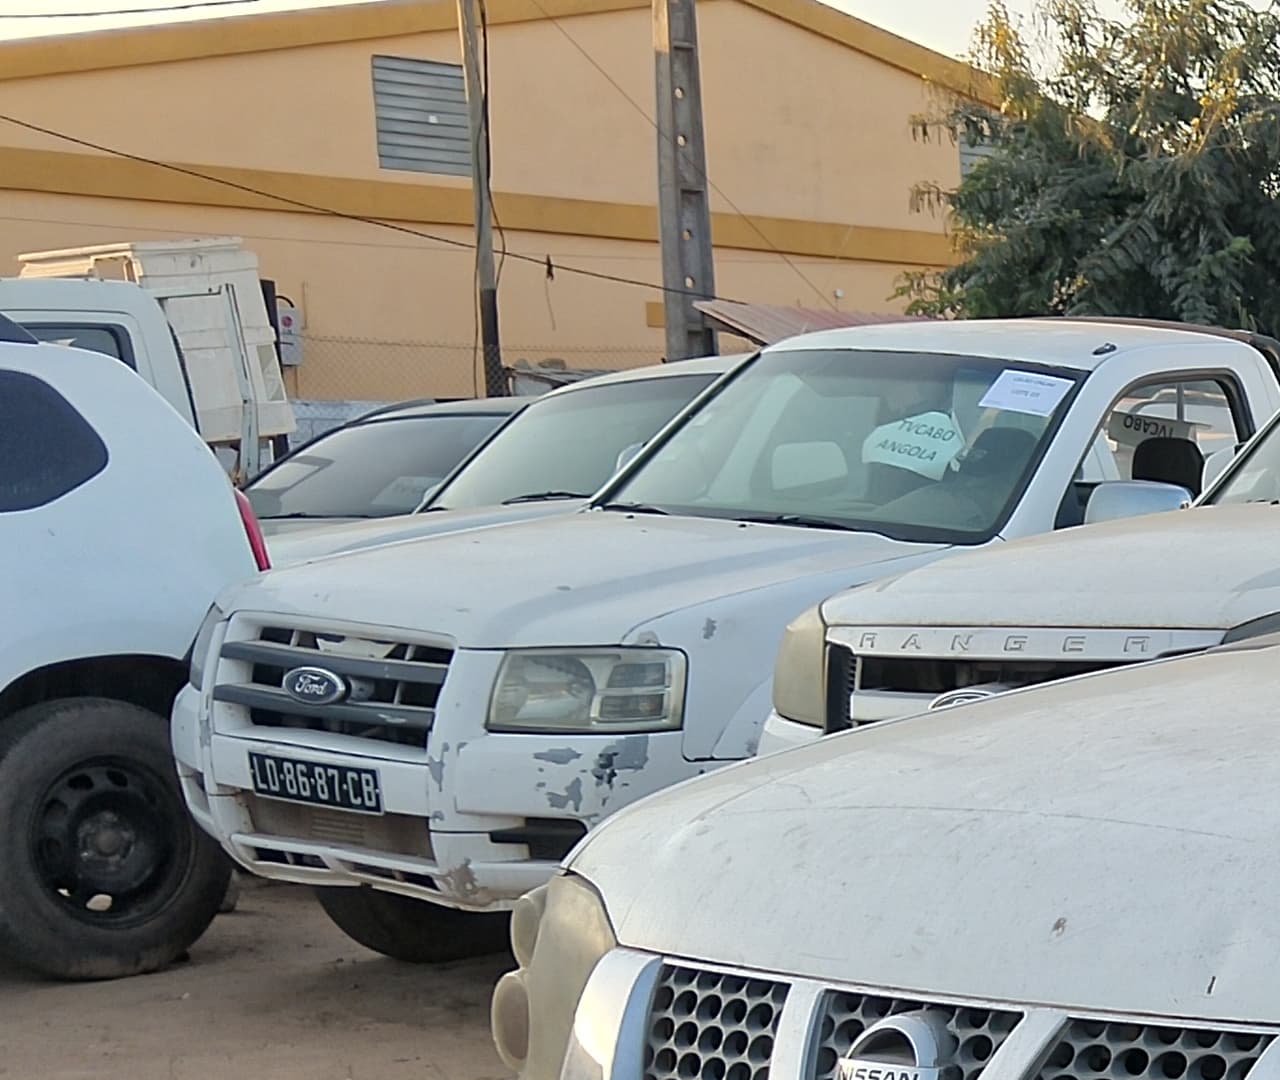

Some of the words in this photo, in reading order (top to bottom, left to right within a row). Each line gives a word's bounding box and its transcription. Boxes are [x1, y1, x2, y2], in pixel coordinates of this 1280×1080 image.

[898, 420, 956, 442] TVCABO
[875, 439, 937, 461] ANGOLA
[859, 632, 1150, 652] RANGER
[295, 673, 328, 696] Ford
